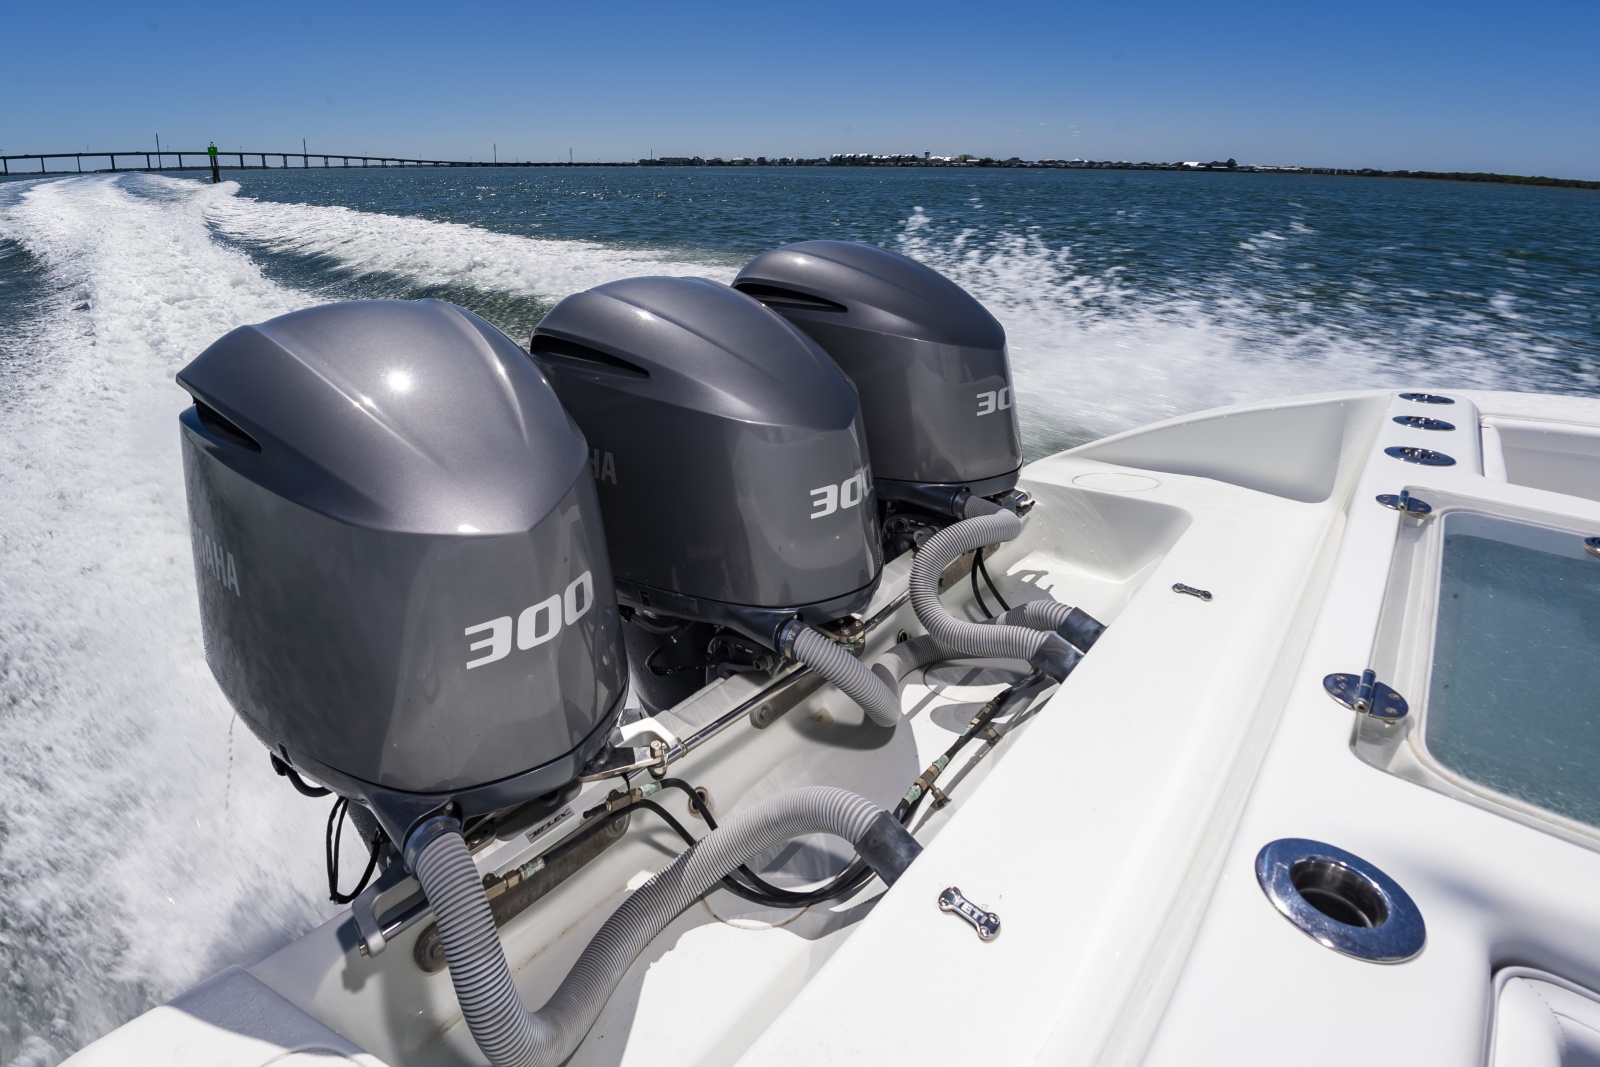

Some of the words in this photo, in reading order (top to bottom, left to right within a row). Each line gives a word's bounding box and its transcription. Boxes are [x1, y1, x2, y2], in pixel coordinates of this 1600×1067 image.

[976, 386, 1013, 417] 30
[809, 463, 873, 520] 300
[464, 570, 593, 670] 300
